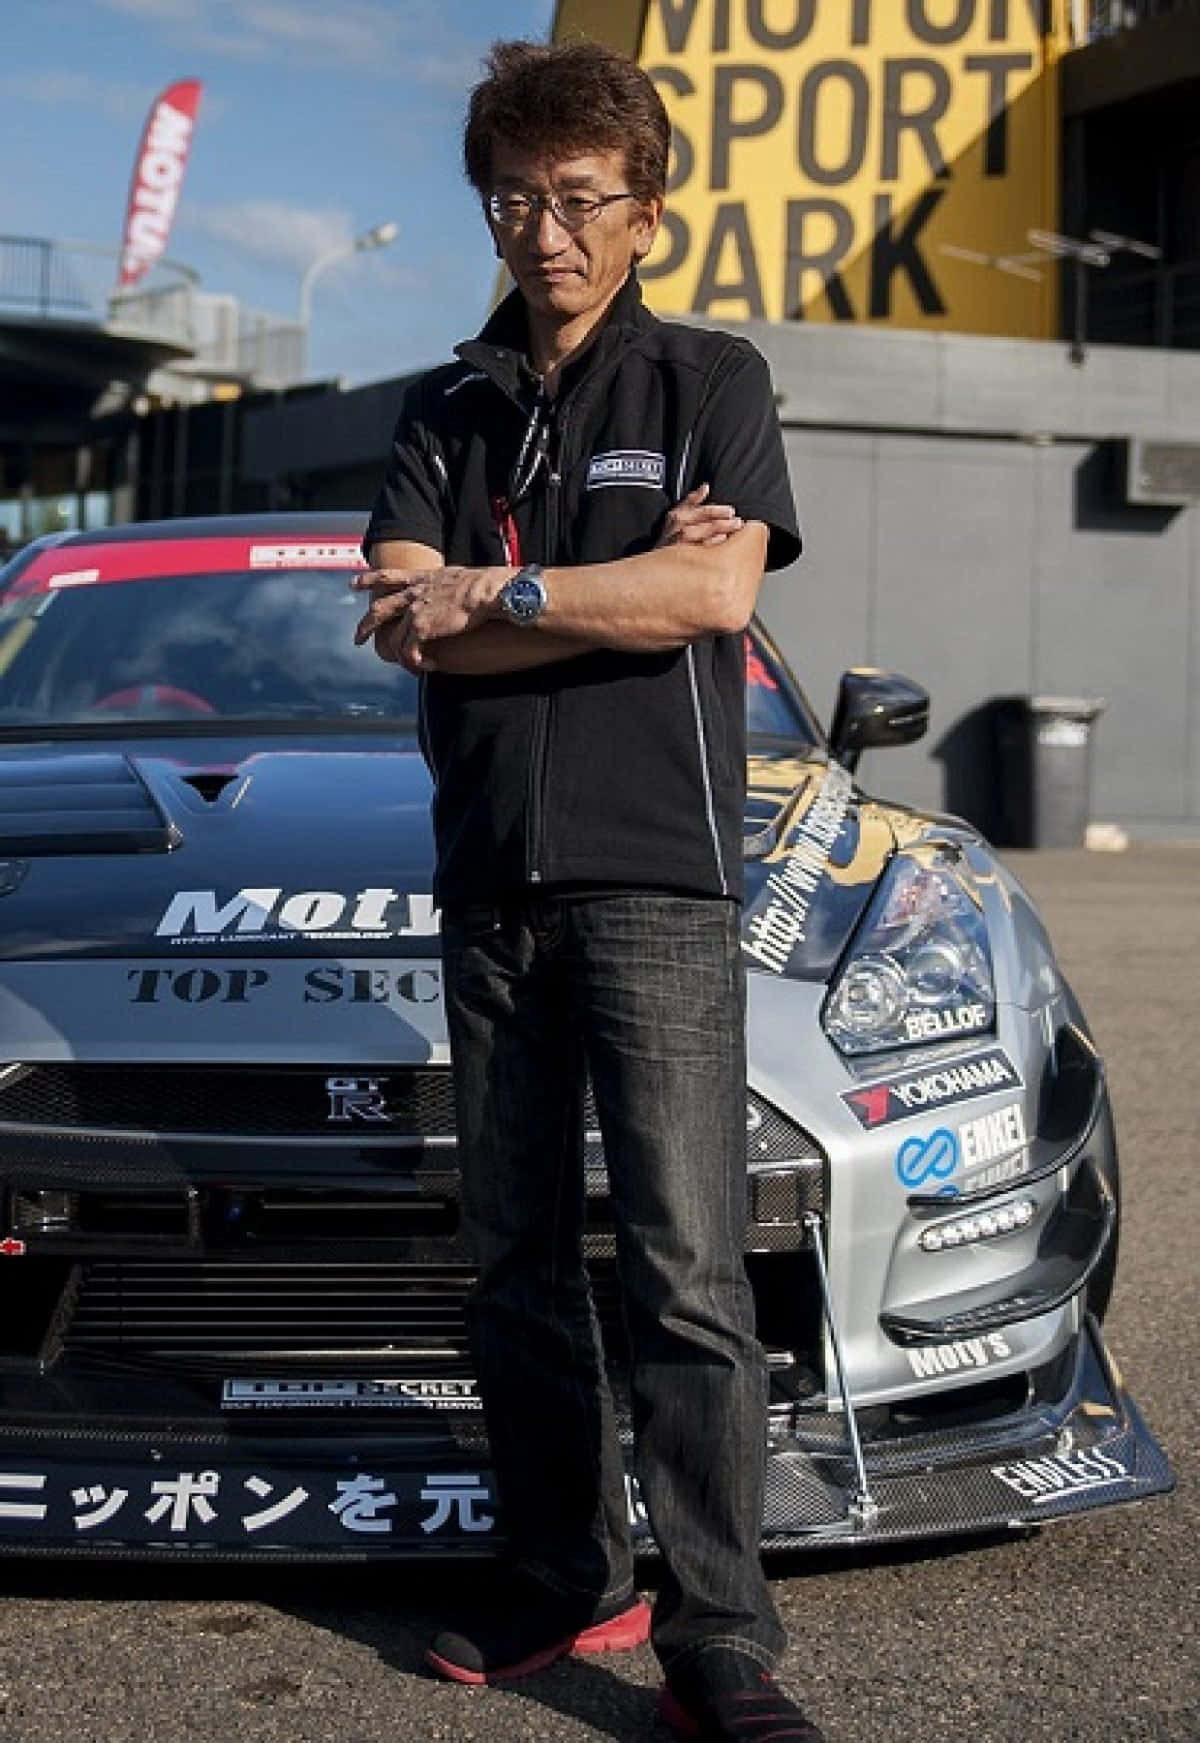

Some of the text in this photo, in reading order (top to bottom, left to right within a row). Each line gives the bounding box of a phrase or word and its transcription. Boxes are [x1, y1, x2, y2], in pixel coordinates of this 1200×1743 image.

[644, 52, 1032, 193] SPORT
[637, 188, 948, 321] PARK
[127, 967, 440, 1004] TOP SEC
[906, 1004, 986, 1040] BELLOF
[889, 1059, 1013, 1108] YOKOHAMA
[958, 1103, 1027, 1170] ENKEI
[905, 1332, 1011, 1378] Moty's
[990, 1446, 1128, 1497] ENDLESS
[0, 1470, 495, 1533] ニッポンを元
